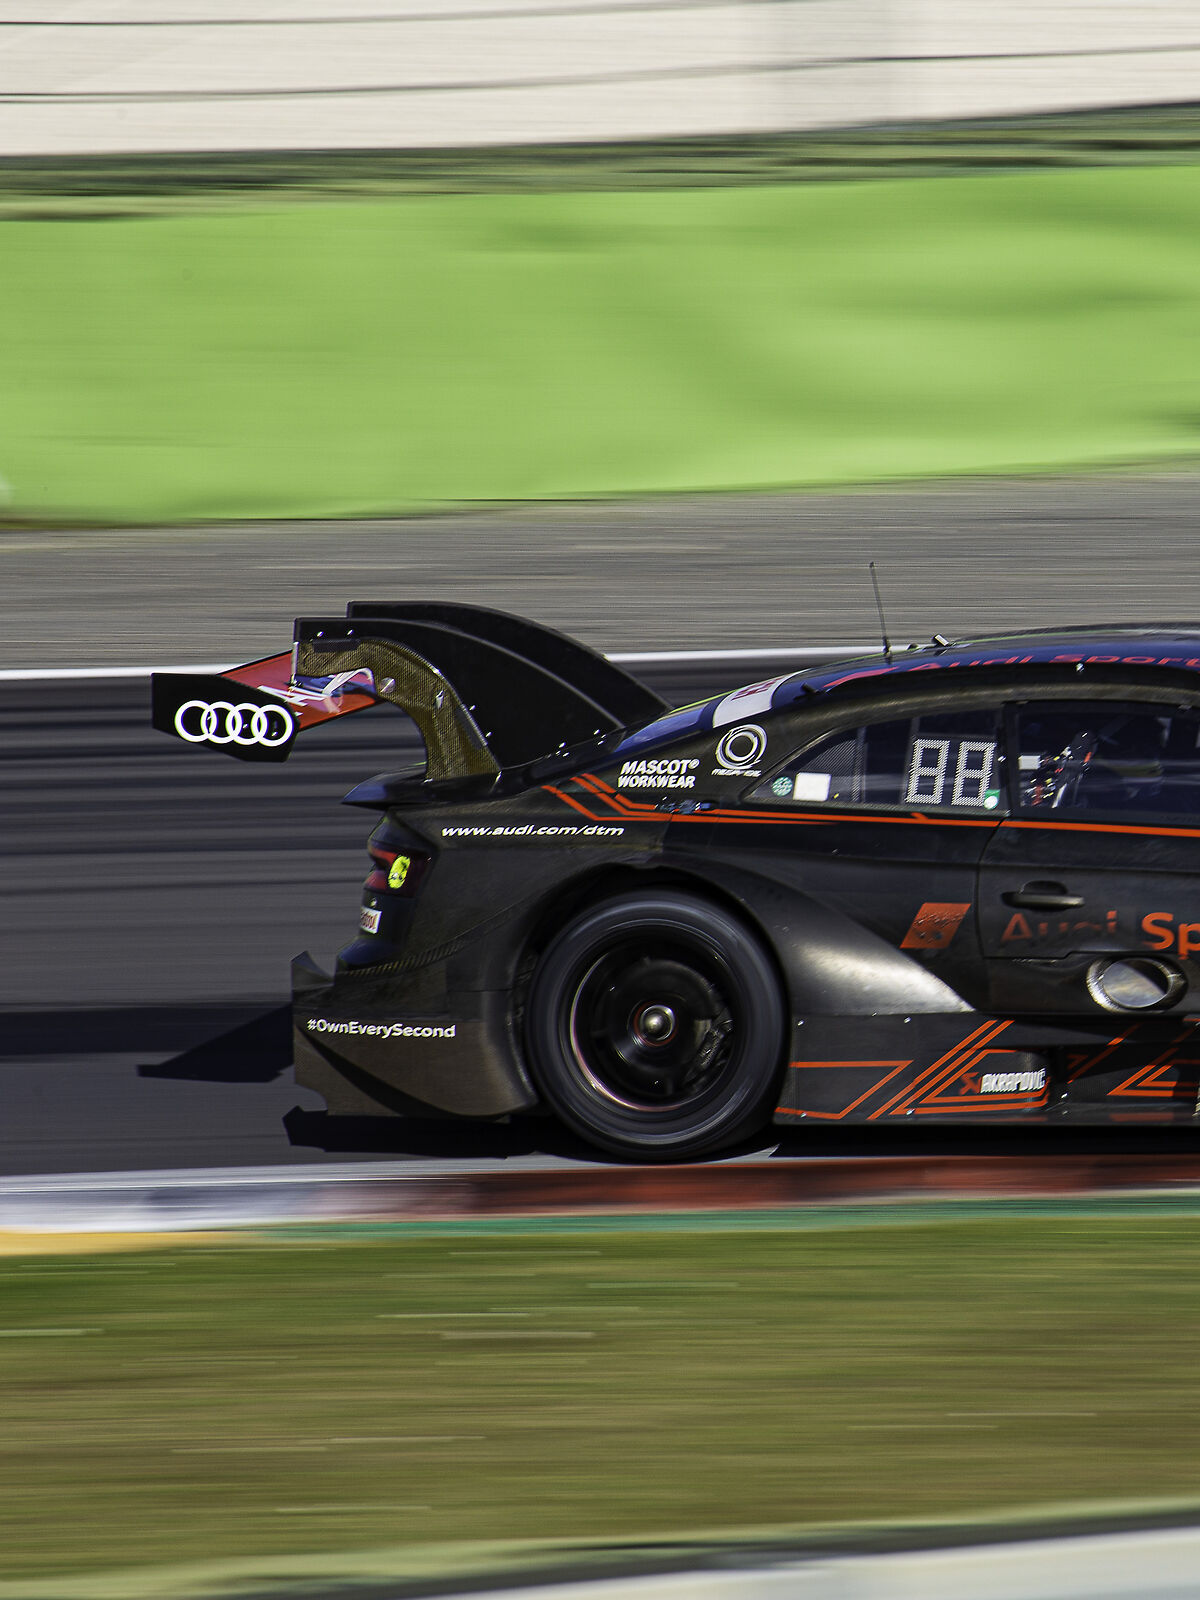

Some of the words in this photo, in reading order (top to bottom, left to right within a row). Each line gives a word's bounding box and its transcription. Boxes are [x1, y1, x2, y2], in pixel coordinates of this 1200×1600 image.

[617, 775, 696, 788] WORKWEAR
[441, 824, 625, 837] www.audi.com/dtm
[306, 1018, 457, 1039] #OwnEverySecond
